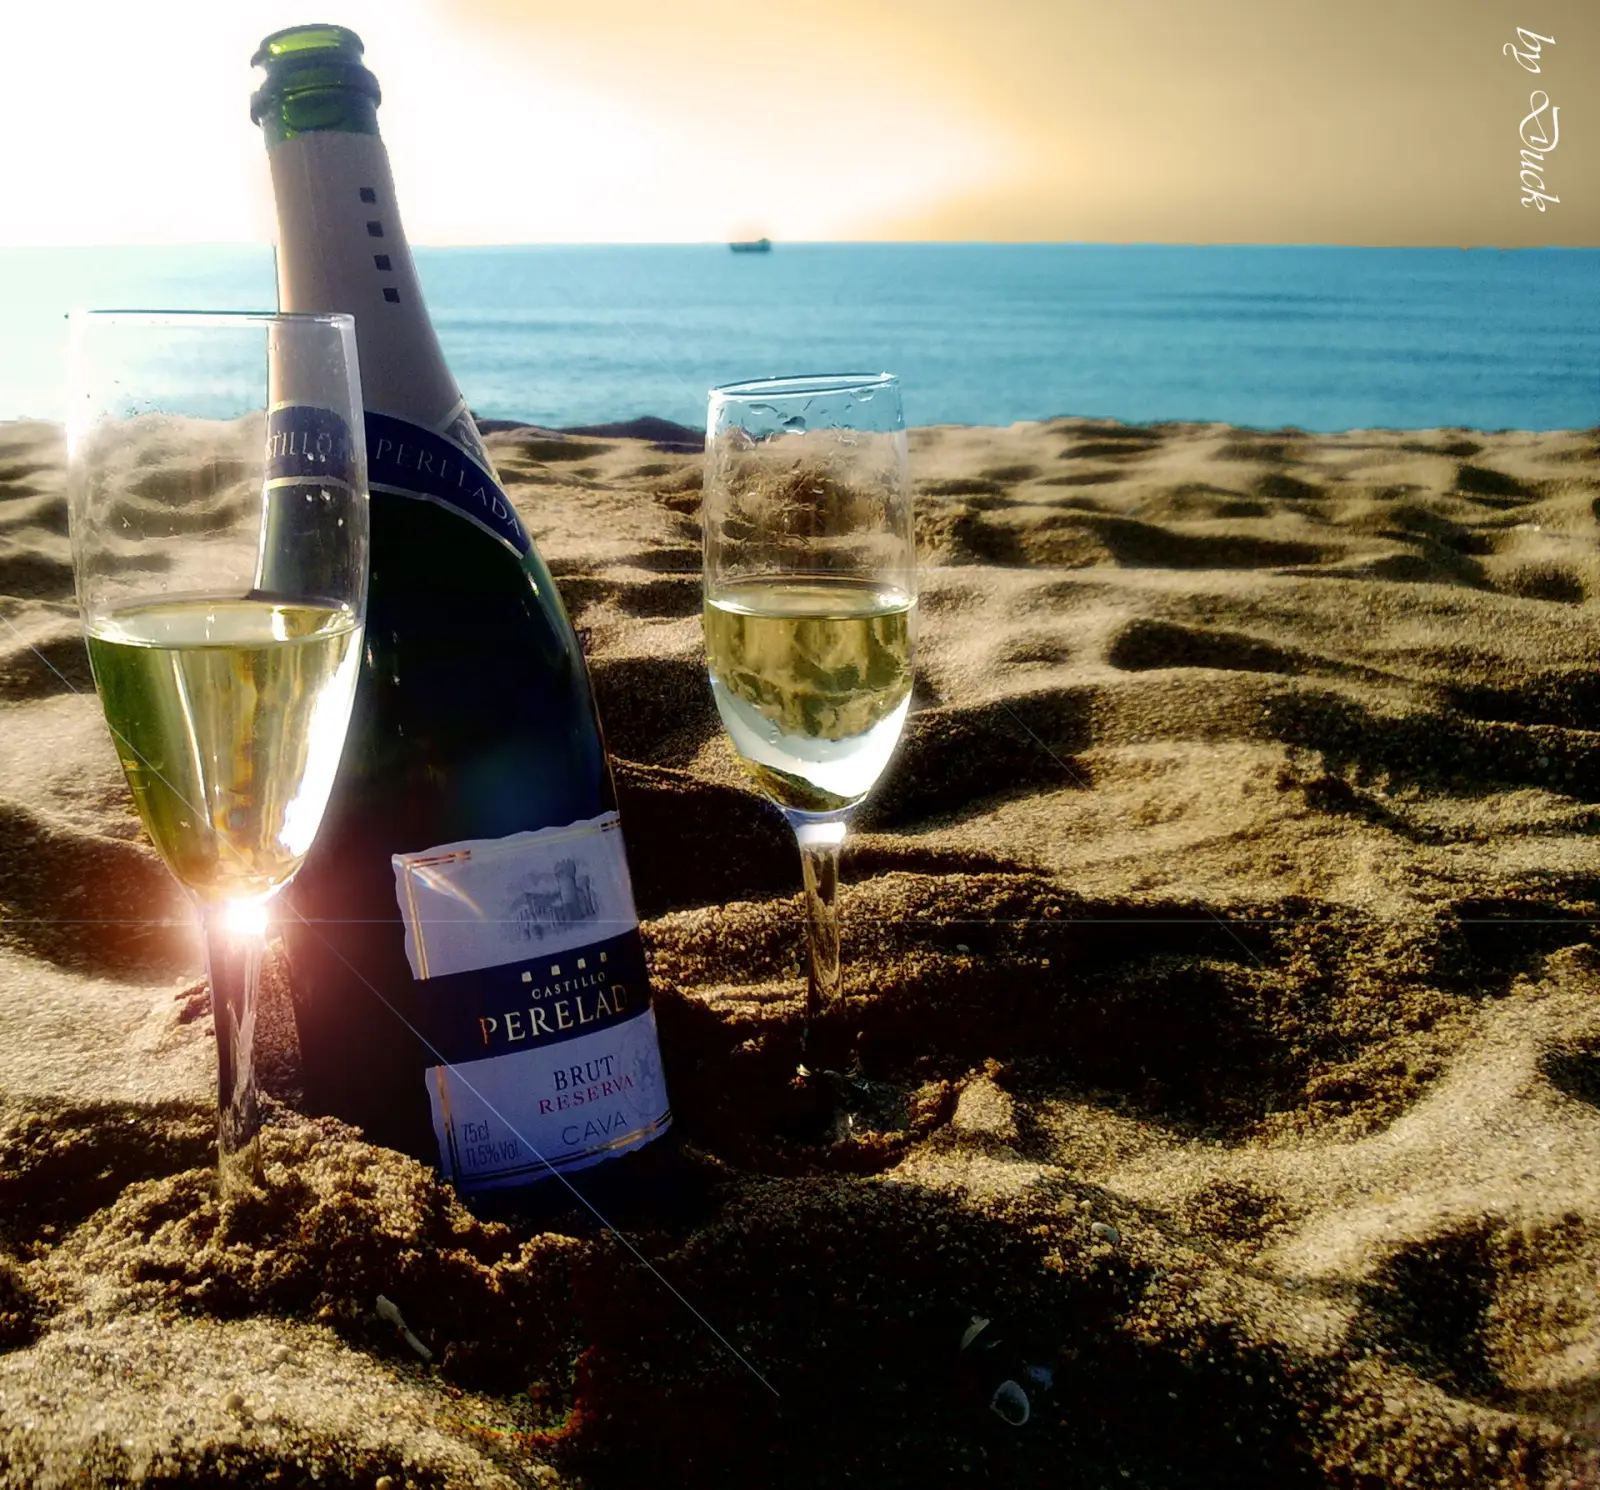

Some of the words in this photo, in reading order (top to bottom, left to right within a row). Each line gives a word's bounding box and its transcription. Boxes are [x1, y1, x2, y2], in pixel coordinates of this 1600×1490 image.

[531, 971, 606, 1000] CASTILLO
[553, 1055, 615, 1091] BRUT
[538, 1075, 635, 1114] RESERVA
[562, 1111, 628, 1146] CAVA
